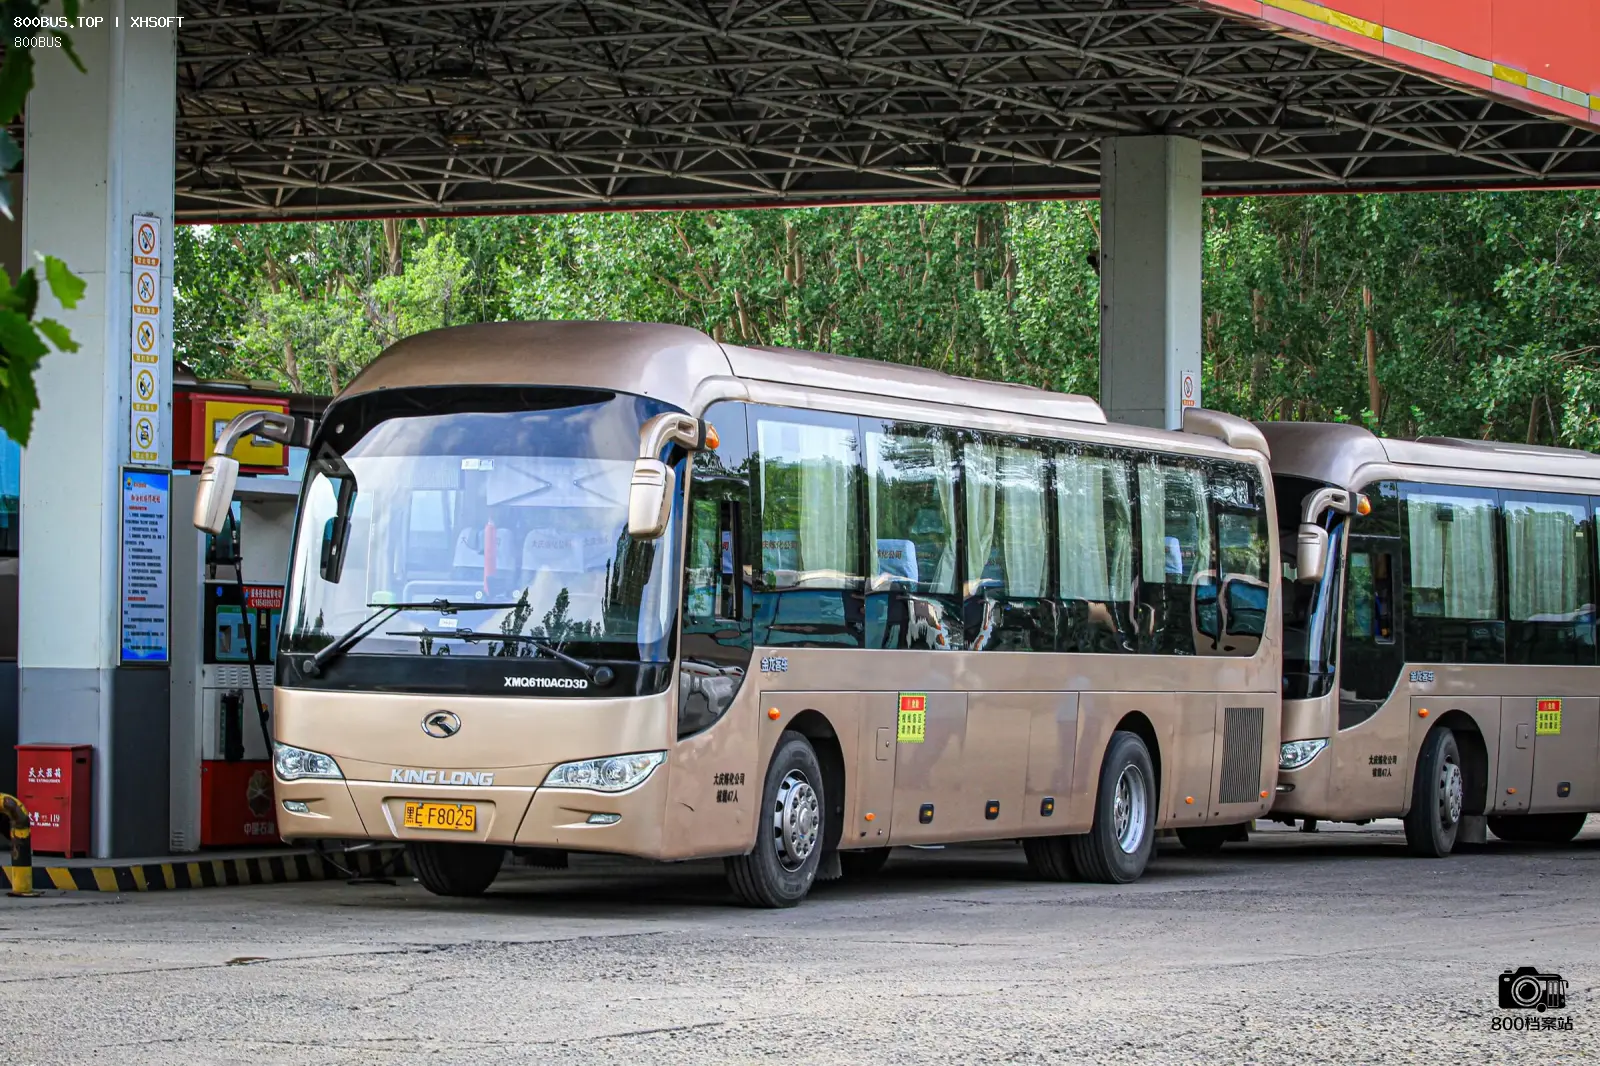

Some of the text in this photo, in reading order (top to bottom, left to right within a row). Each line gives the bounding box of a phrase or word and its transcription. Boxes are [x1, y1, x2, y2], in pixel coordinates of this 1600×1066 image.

[760, 656, 789, 672] 金龙客车
[503, 676, 588, 689] XMQ6110ACD3D
[28, 767, 62, 778] 灭火器箱
[390, 768, 494, 786] KING LONG
